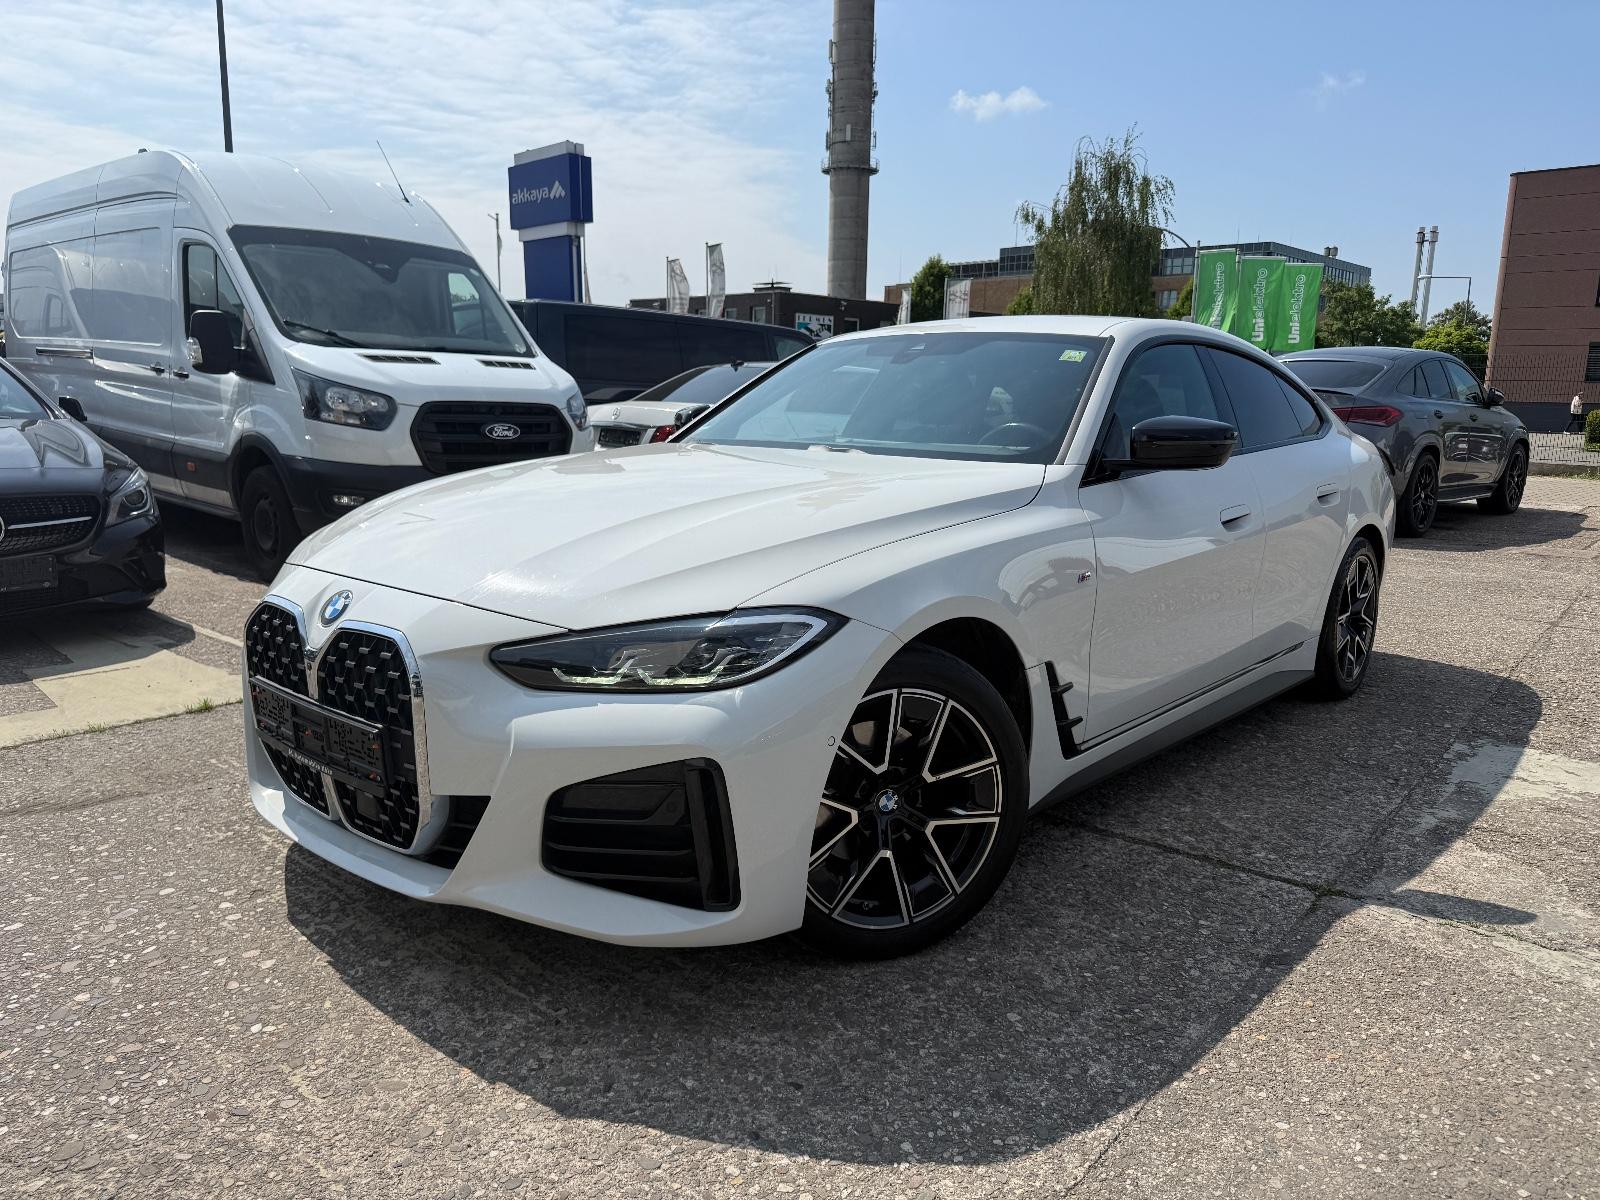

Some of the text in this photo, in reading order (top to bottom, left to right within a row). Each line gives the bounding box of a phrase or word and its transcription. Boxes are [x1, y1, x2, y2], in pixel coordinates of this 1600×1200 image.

[512, 186, 549, 205] akkaya
[1251, 268, 1267, 341] Unielektro
[1288, 274, 1305, 343] Unielektro
[492, 425, 514, 437] Ford
